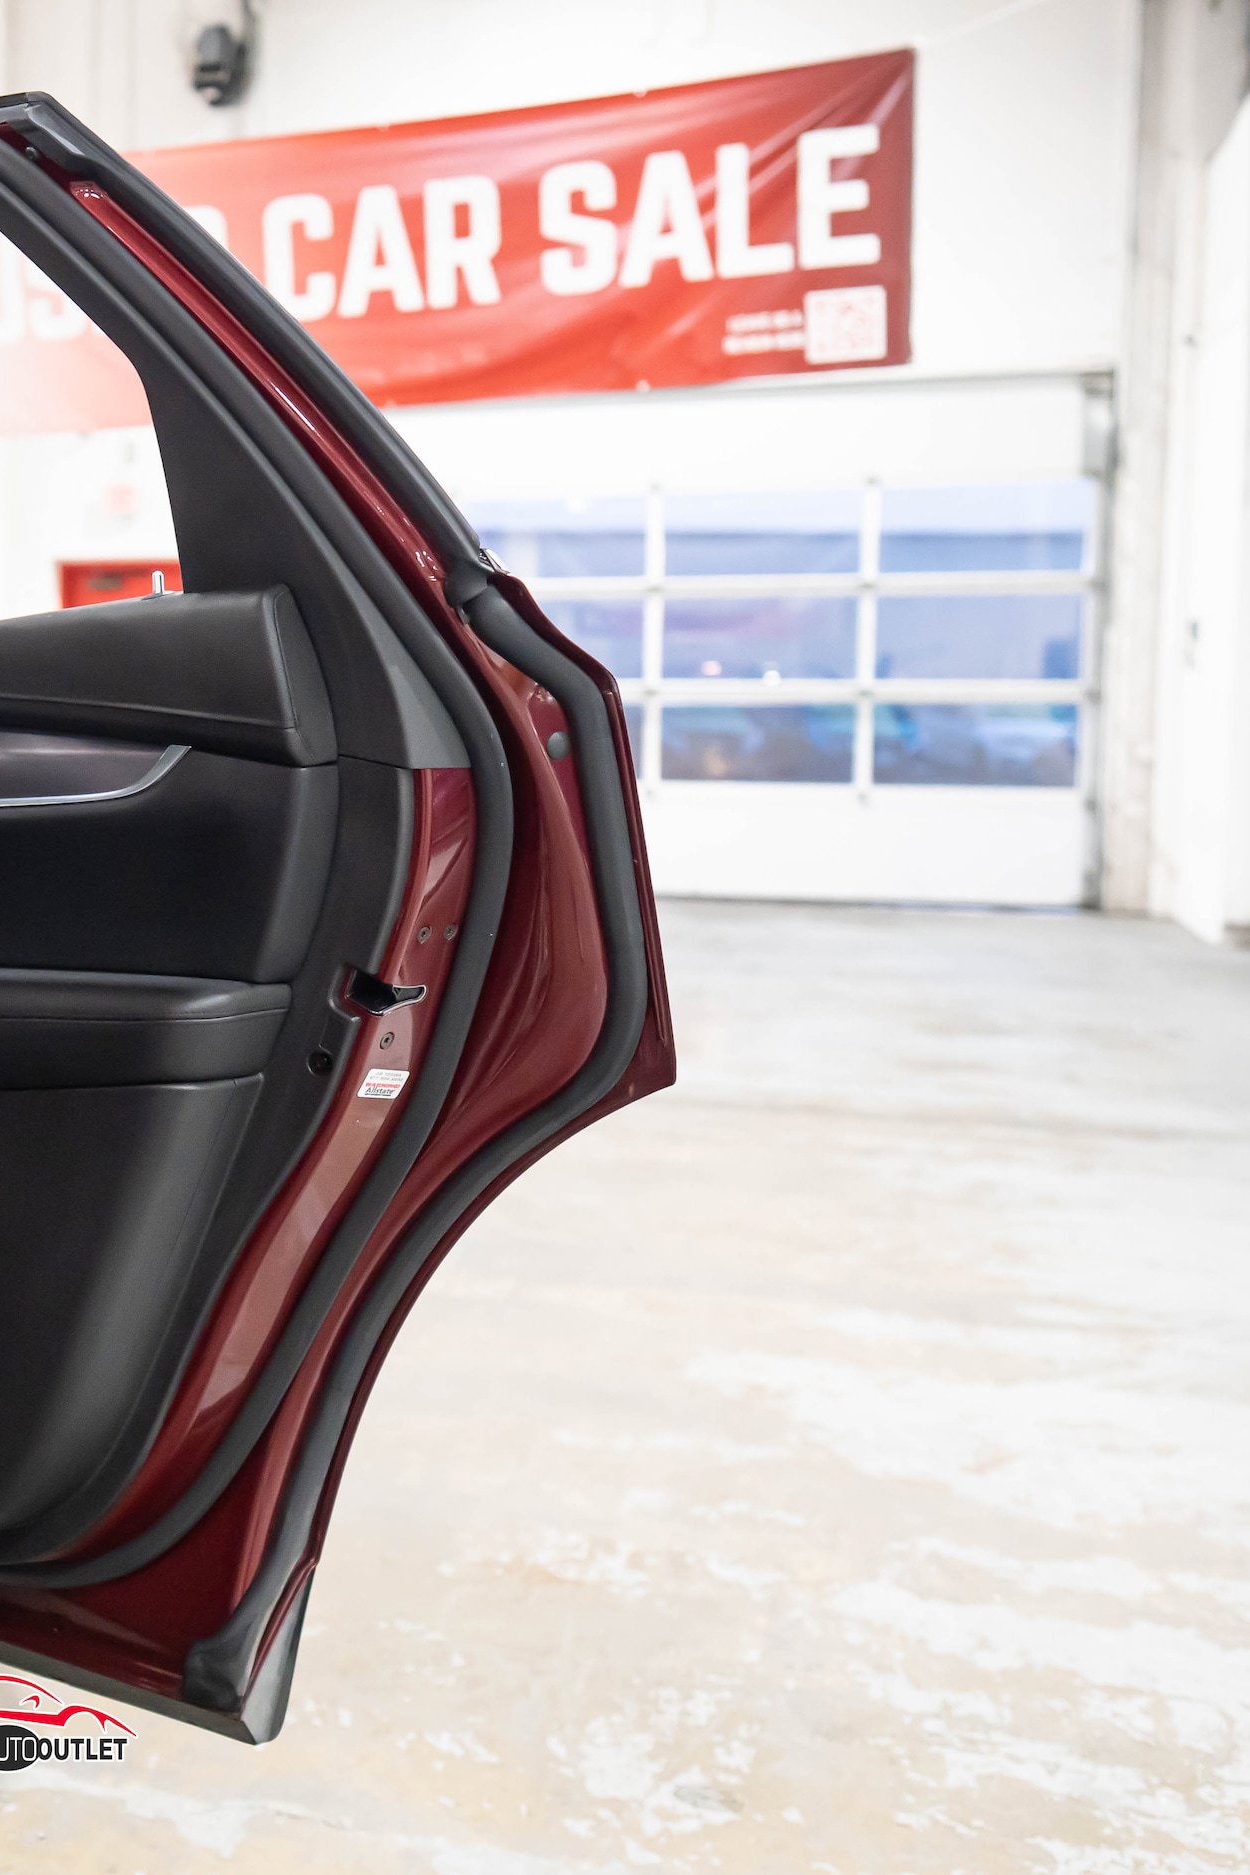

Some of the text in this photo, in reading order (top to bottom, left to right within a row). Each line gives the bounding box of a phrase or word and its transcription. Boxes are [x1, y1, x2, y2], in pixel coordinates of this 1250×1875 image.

[264, 181, 500, 318] CAR
[538, 123, 882, 298] SALE
[366, 1086, 395, 1094] Allstate
